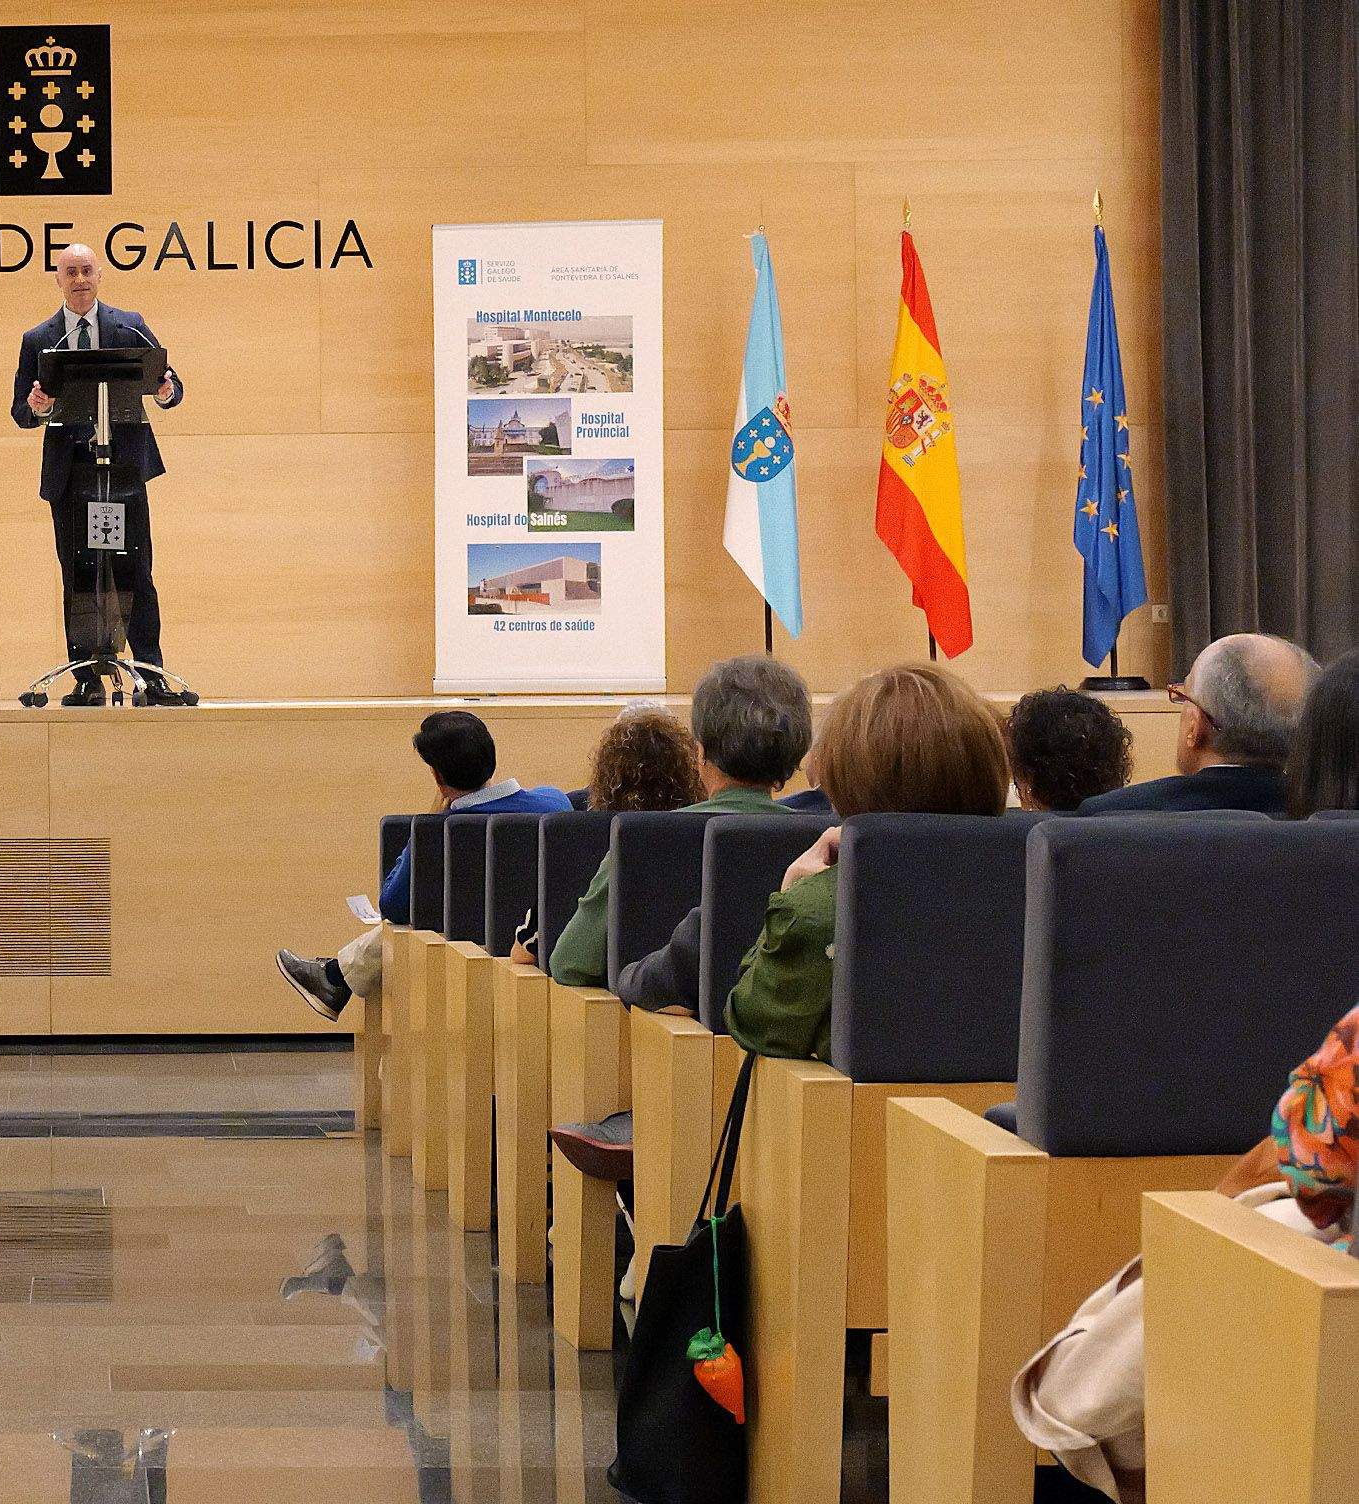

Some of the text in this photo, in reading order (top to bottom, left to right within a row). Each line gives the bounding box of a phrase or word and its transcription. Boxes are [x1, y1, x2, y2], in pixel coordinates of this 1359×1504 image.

[104, 219, 374, 272] GALICIA
[487, 267, 516, 275] GALEGO
[476, 309, 582, 324] Hospital Montecelo
[581, 412, 624, 427] Hospital
[576, 425, 629, 438] Provincial
[466, 511, 568, 528] Hospital do Salnés
[493, 618, 595, 632] 42 centros de saúde
